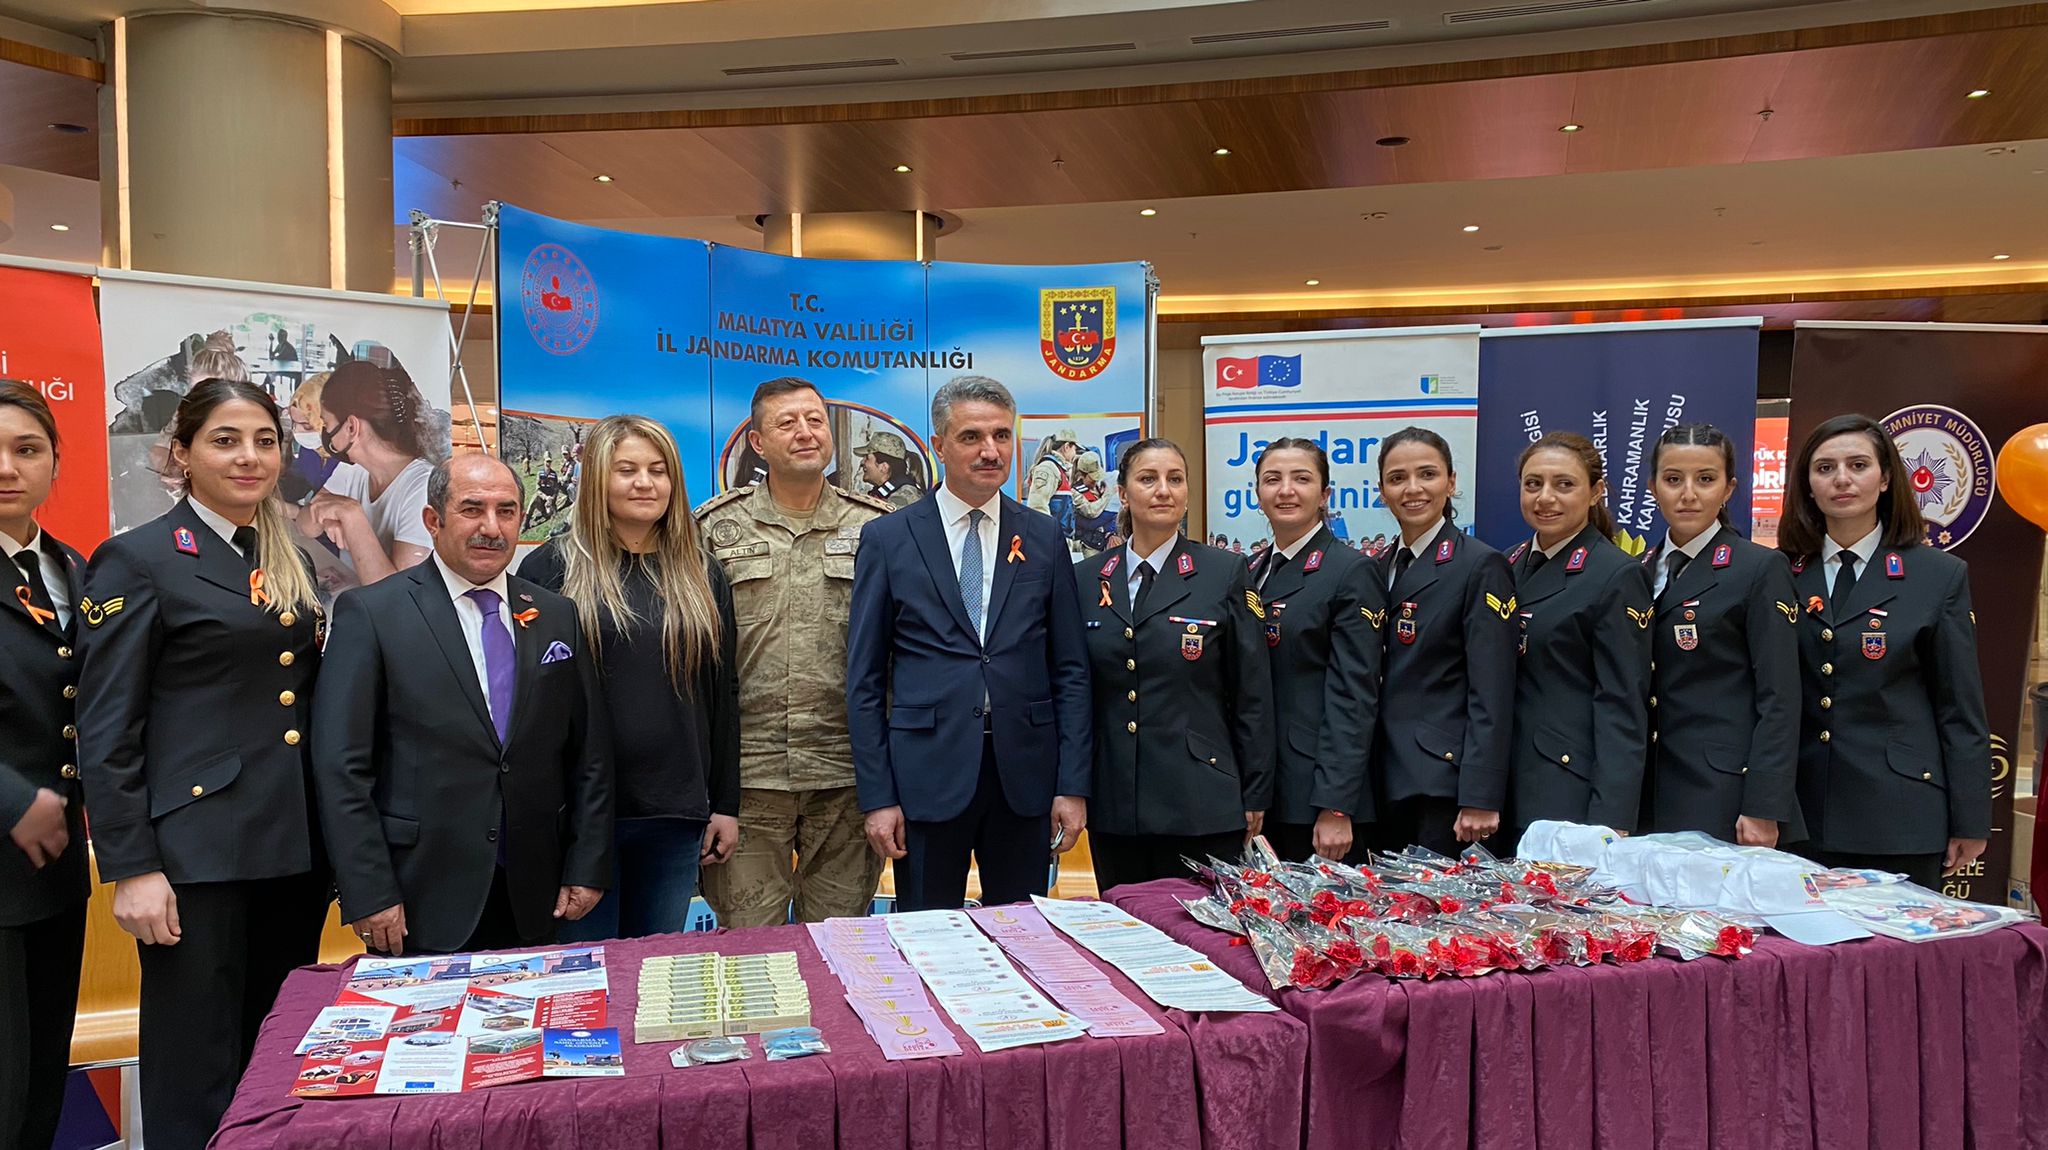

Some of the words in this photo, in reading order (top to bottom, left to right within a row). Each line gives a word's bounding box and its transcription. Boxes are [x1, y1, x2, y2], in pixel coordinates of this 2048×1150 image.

[789, 292, 825, 312] T.C.
[718, 311, 808, 339] MALATYA
[814, 317, 914, 341] VALİLİĞİ
[657, 327, 677, 353] İL
[685, 335, 800, 367] JANDARMA
[808, 346, 973, 369] KOMUTANLIĞI
[1045, 347, 1112, 378] JANDARMA
[1519, 409, 1543, 444] GİSİ
[1617, 398, 1650, 525] KAHRAMANLIK
[1944, 418, 1989, 497] MÜDÜRLÜĞÜ
[730, 546, 755, 557] ALTIN
